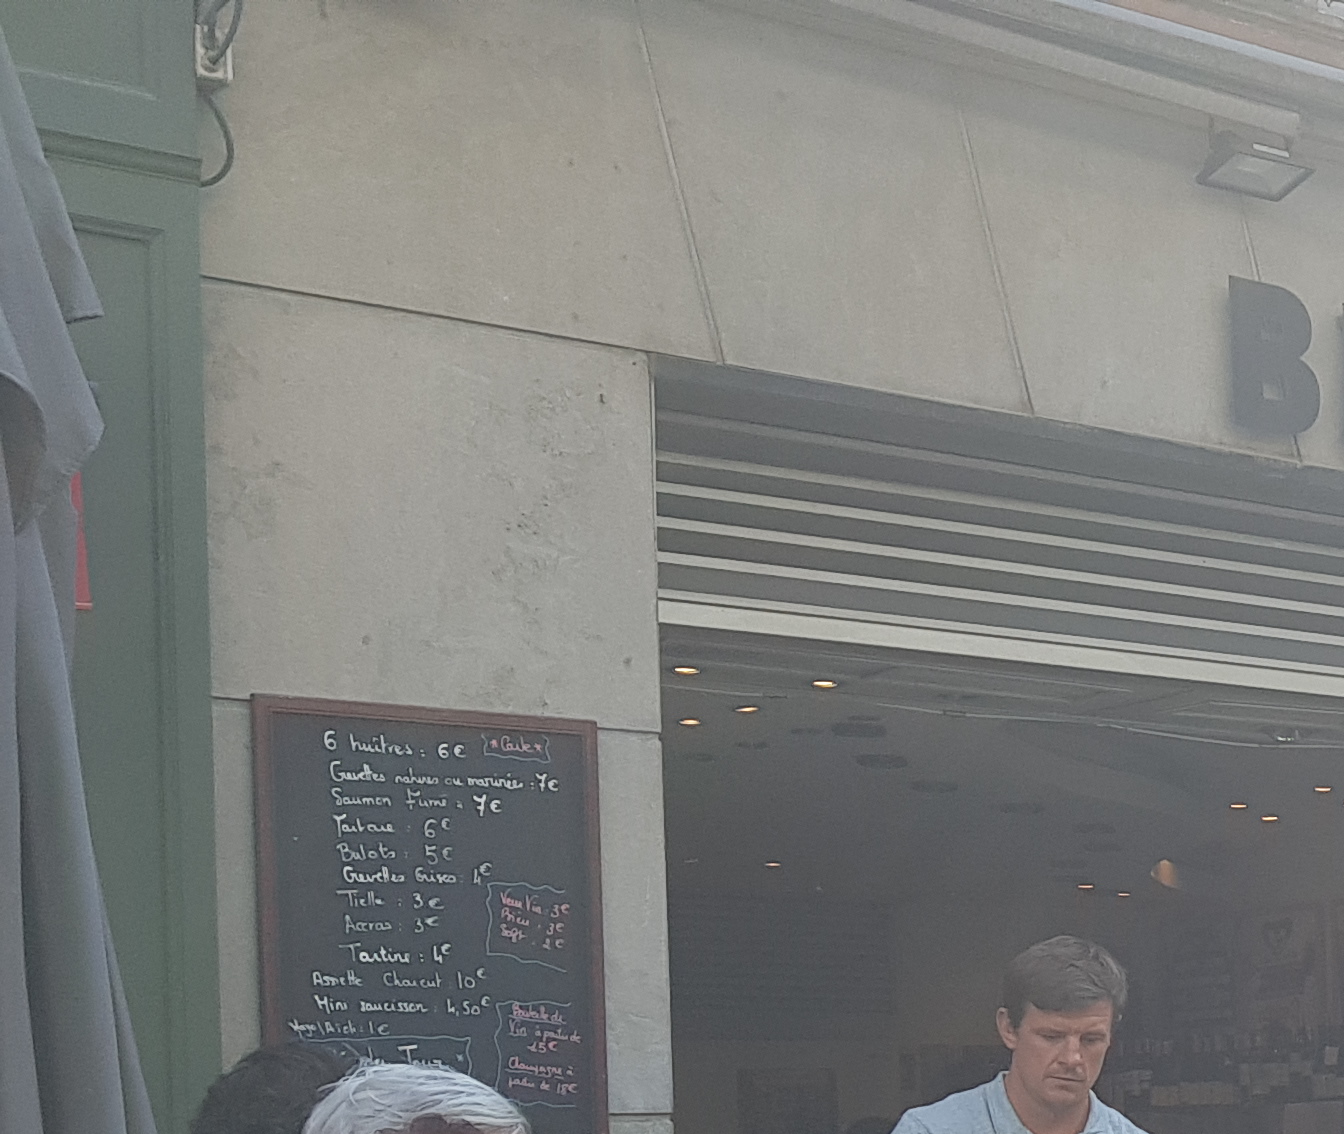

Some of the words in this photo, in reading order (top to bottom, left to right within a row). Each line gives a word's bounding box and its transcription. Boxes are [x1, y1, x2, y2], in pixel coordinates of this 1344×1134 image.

[323, 730, 337, 750] 6
[349, 733, 413, 757] huîtres
[445, 778, 463, 787] ou
[331, 788, 391, 807] Saumon
[336, 842, 396, 862] Bulots
[344, 914, 392, 934] Accras
[338, 943, 410, 963] Tartine
[382, 970, 443, 988] Charcut
[314, 995, 348, 1014] Mini
[360, 998, 429, 1013] saucisson
